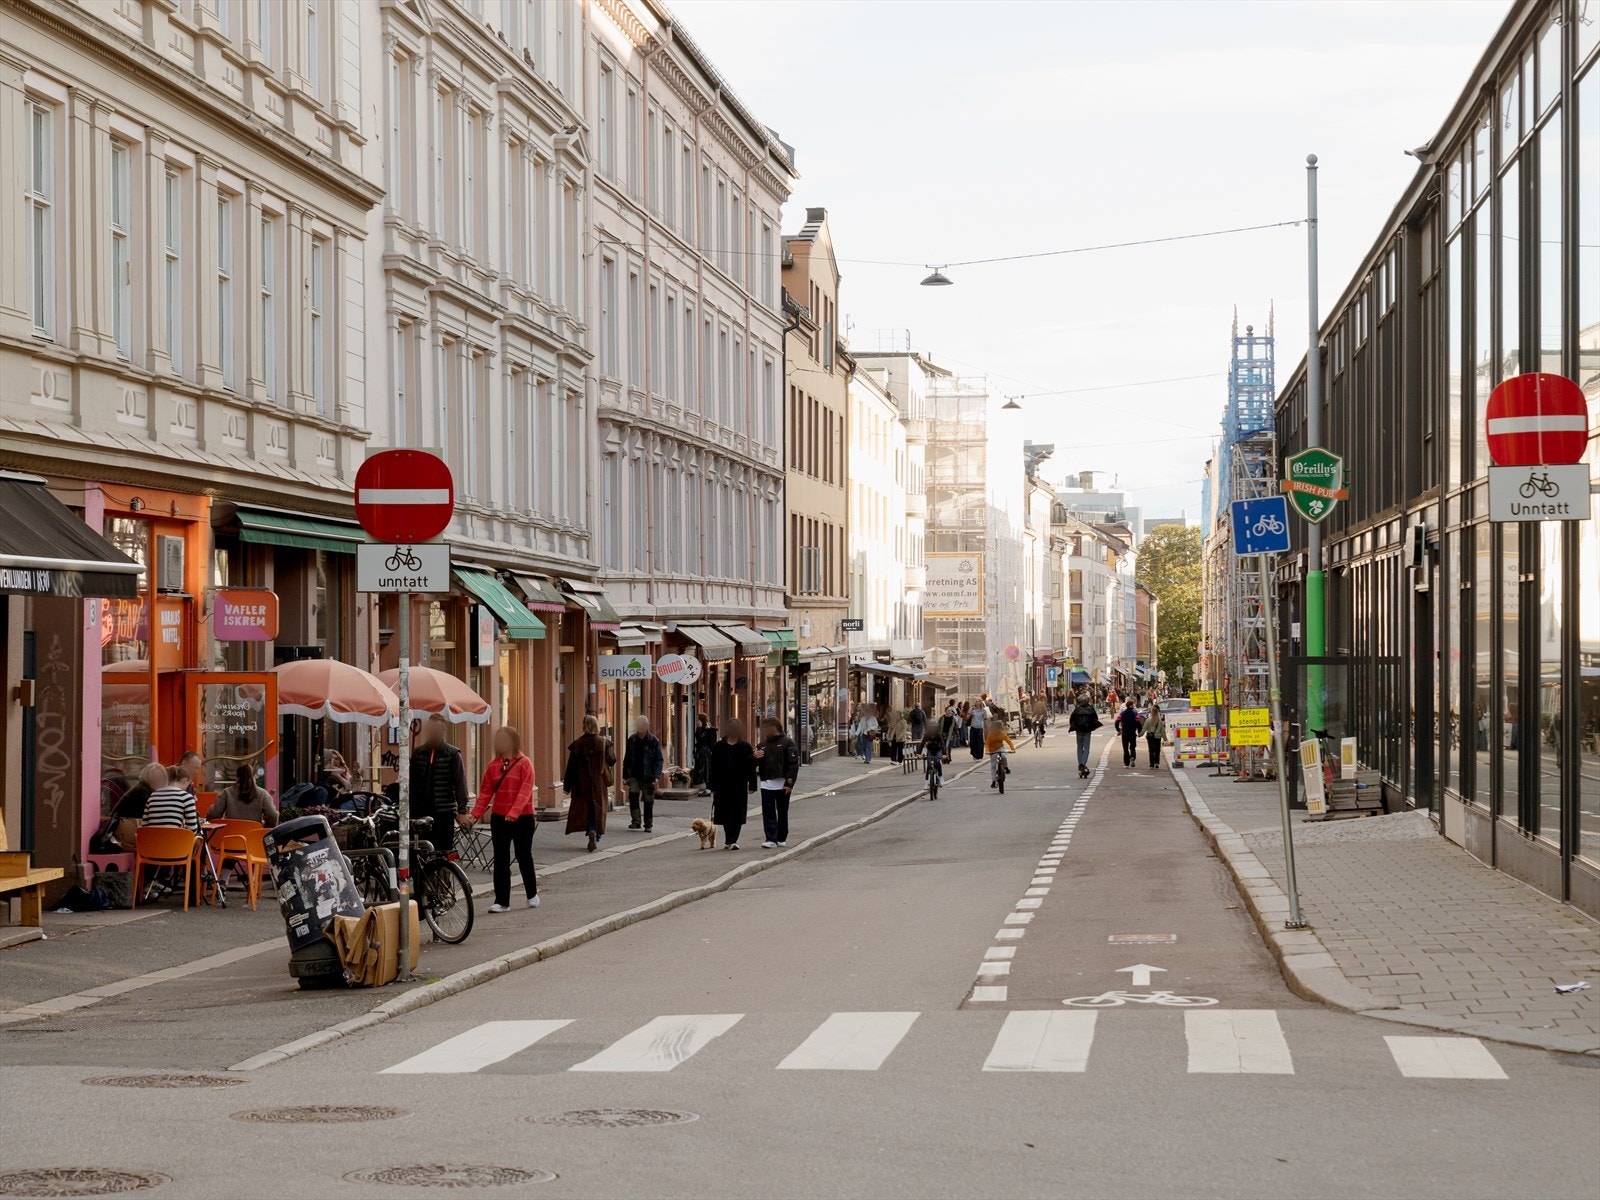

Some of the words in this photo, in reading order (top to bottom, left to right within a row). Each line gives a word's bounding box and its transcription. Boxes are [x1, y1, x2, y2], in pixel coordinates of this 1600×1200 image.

[1293, 482, 1315, 494] IRISH
[1317, 487, 1334, 498] PUB
[1511, 502, 1570, 515] Unntatt
[378, 575, 429, 588] unntatt
[966, 577, 977, 586] AS
[224, 604, 266, 615] VAFLER
[223, 616, 266, 626] ISKREM
[601, 666, 646, 677] sunkost
